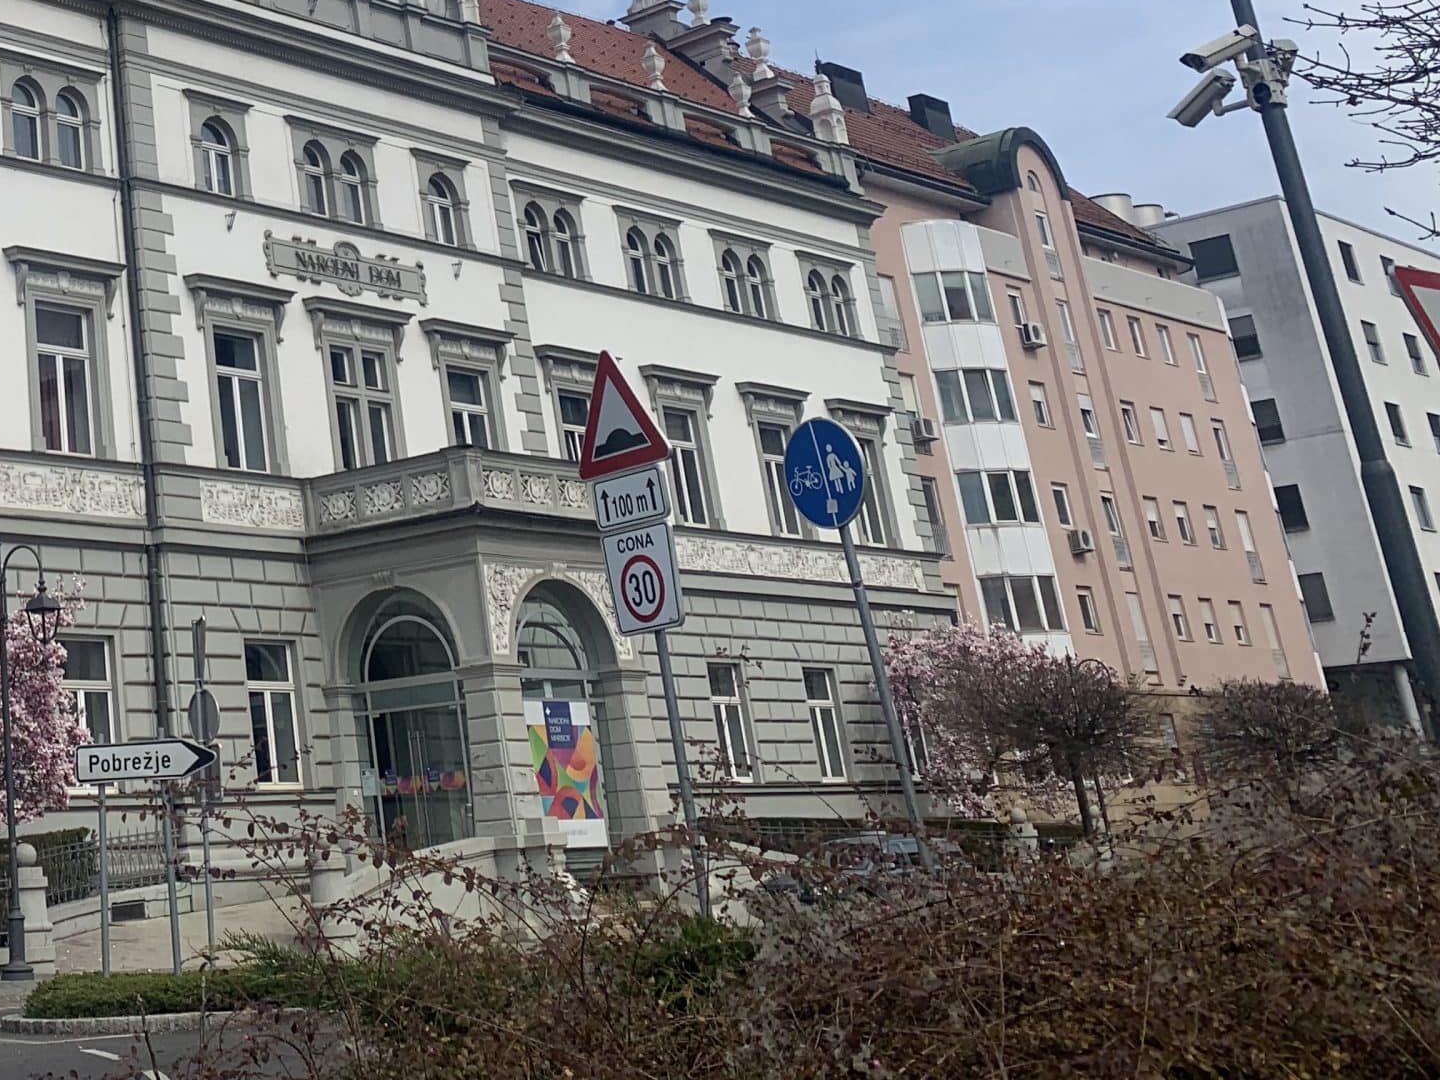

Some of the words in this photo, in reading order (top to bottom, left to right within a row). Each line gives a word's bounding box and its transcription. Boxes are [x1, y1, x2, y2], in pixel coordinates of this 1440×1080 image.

[612, 494, 634, 518] 100
[636, 495, 649, 512] m
[617, 532, 654, 553] CONA
[629, 570, 656, 607] 30
[89, 751, 171, 774] Pobrežje
